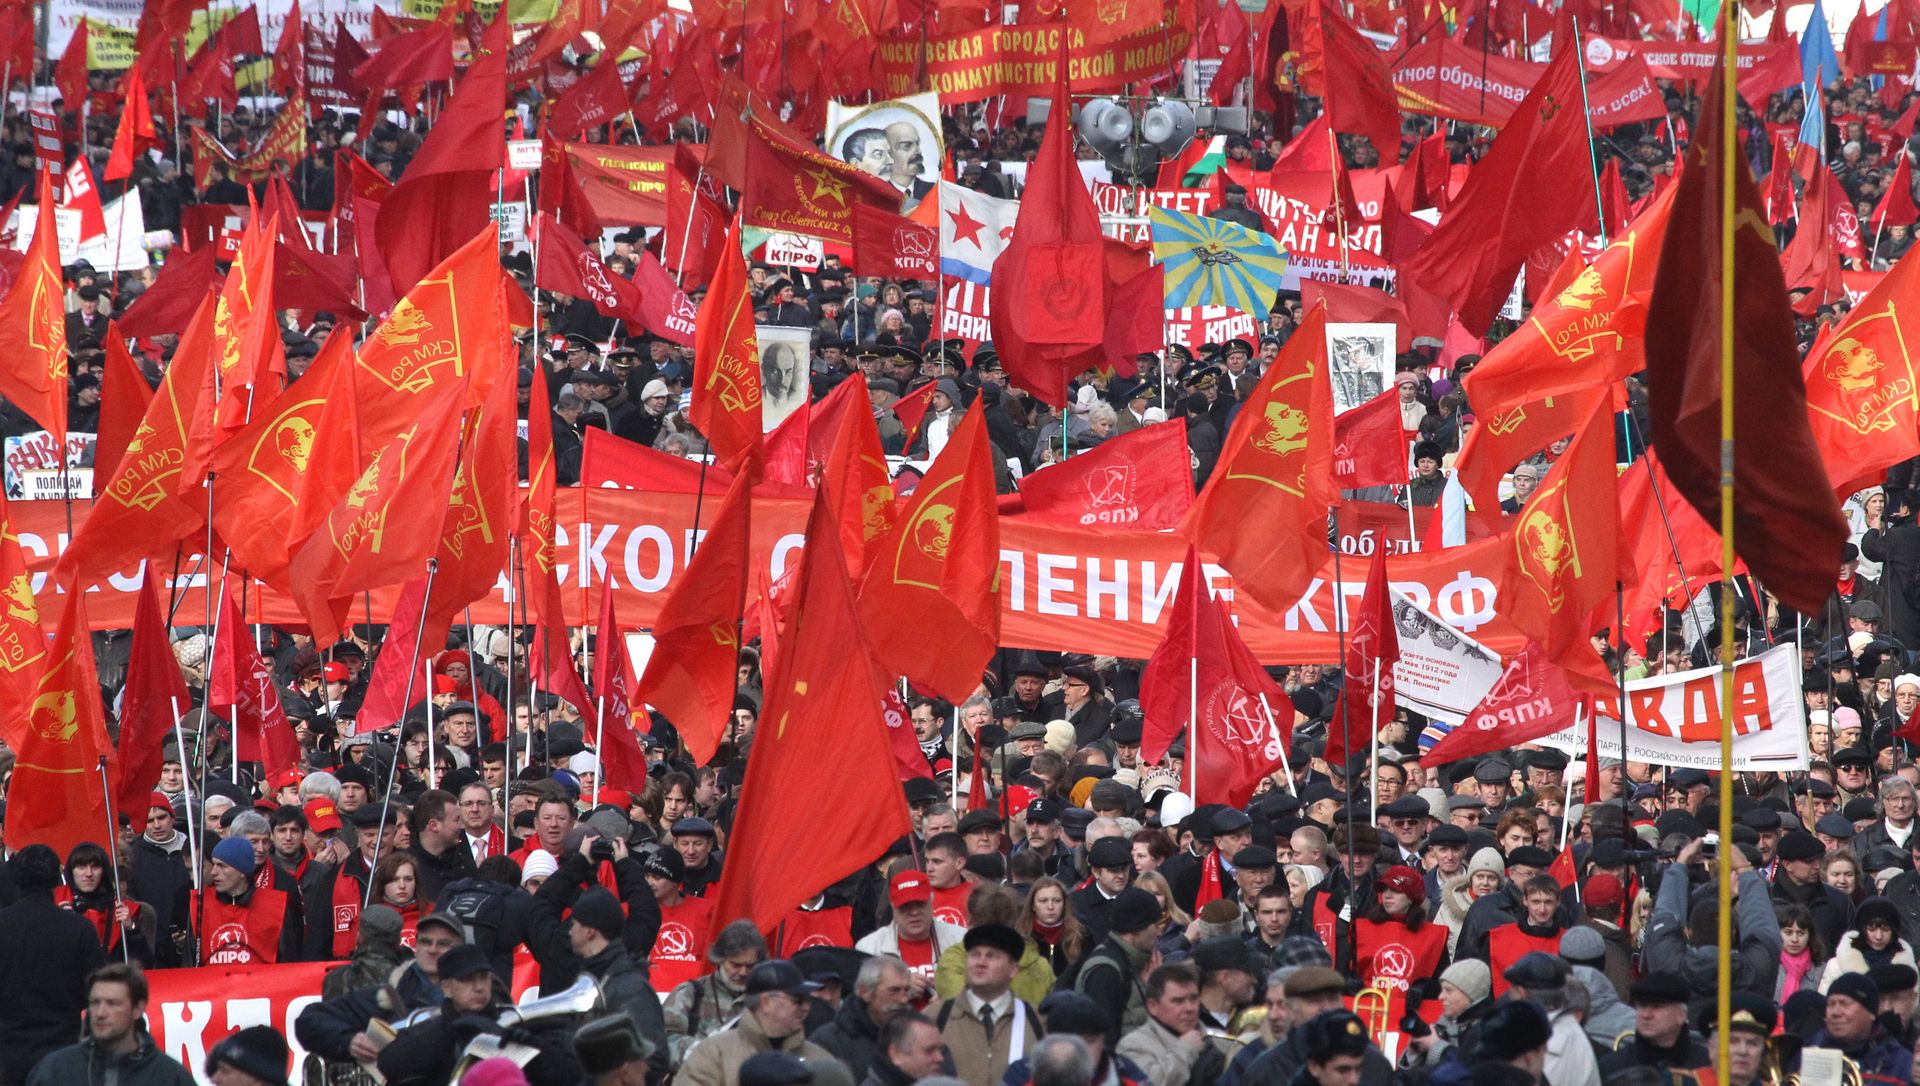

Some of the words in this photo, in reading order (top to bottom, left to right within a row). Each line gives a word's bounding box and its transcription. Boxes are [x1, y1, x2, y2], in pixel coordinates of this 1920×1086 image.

[930, 50, 1115, 95] КОММУНИСТИЧСКОЙ
[1440, 64, 1531, 102] образова
[895, 256, 935, 273] КПРФ
[665, 314, 696, 335] КПР
[720, 354, 749, 380] СКМ
[742, 375, 759, 402] РФ
[1421, 662, 1439, 674] 1912
[1440, 669, 1458, 678] года
[1425, 657, 1460, 670] основана
[1407, 670, 1451, 686] инициативе
[1412, 680, 1440, 691] Ленина
[1634, 746, 1693, 764] РОССИЙСКОЙ
[209, 950, 251, 965] КПРФ
